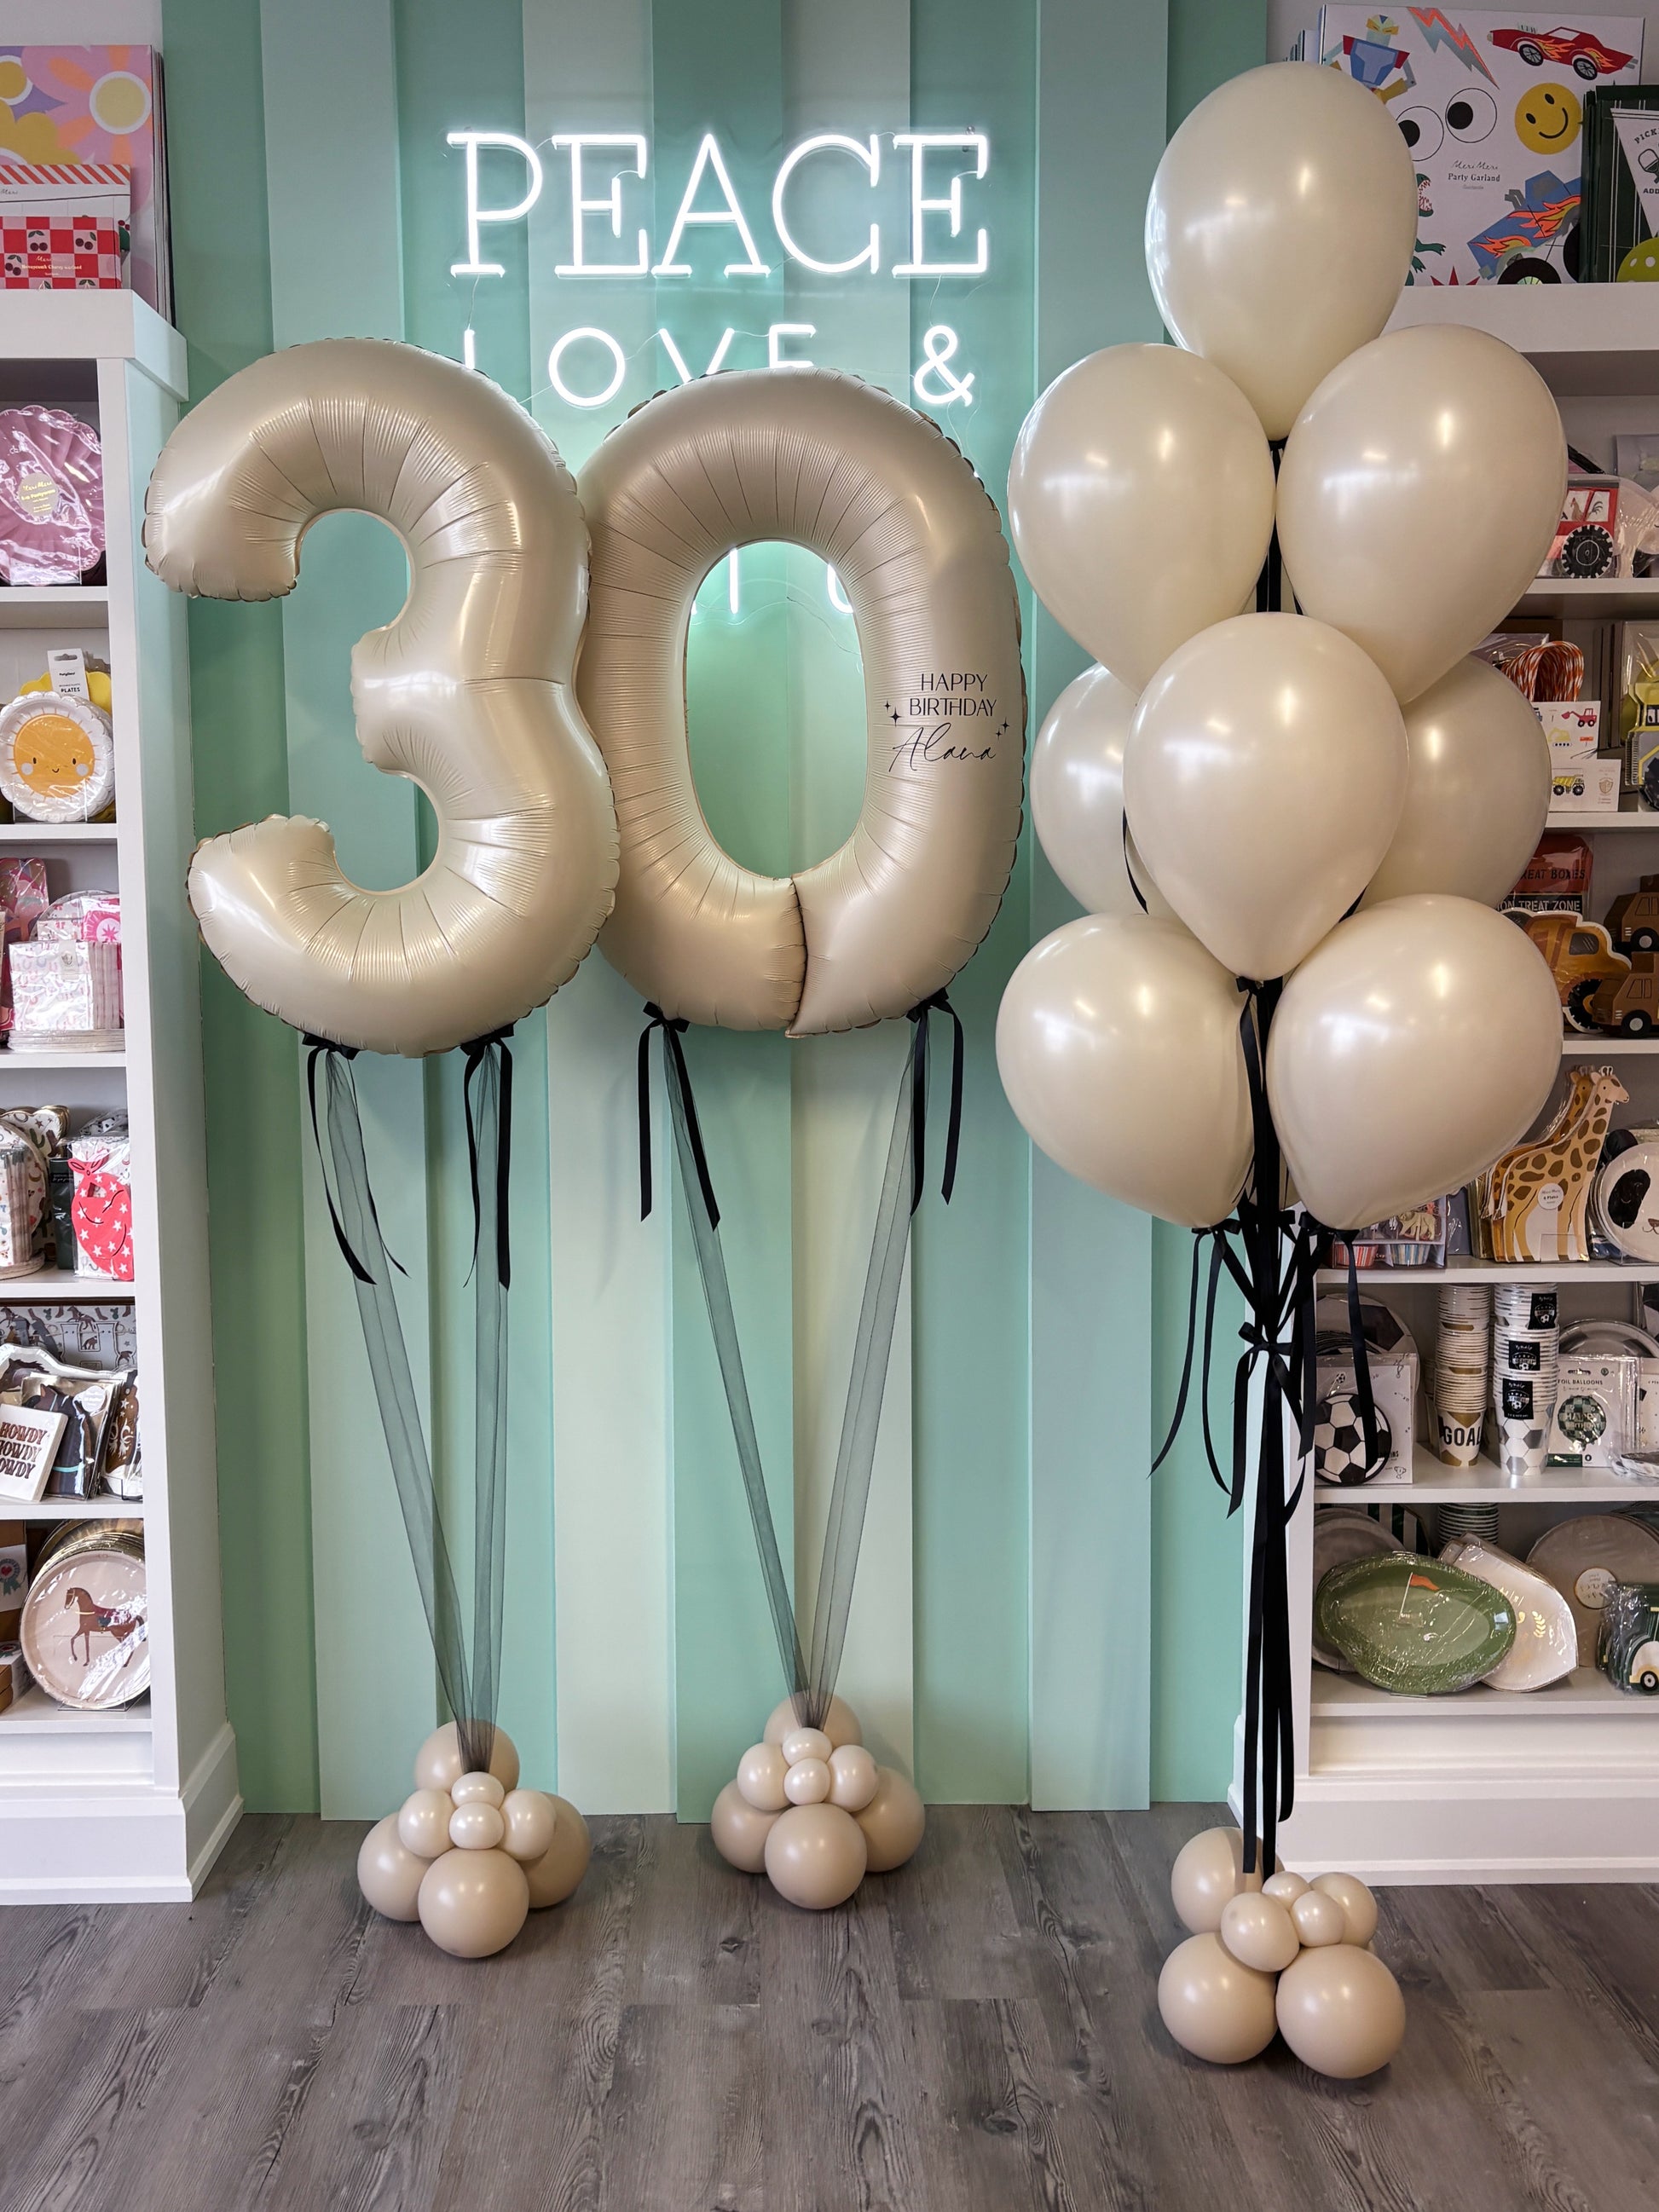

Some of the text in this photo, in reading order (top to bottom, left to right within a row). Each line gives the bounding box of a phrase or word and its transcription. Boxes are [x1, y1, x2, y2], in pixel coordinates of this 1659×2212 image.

[1634, 127, 1659, 144] PICK
[1448, 172, 1500, 182] Party Garland
[447, 133, 988, 278] PEACE
[913, 325, 976, 407] &
[921, 673, 988, 692] HAPPY
[910, 697, 997, 717] BIRTHDAY
[1520, 869, 1586, 880] REAT BOXES
[1518, 900, 1550, 911] TREAT
[1552, 900, 1581, 911] ZONE
[0, 1422, 49, 1445] HOWDY
[1442, 1425, 1481, 1447] GOAL
